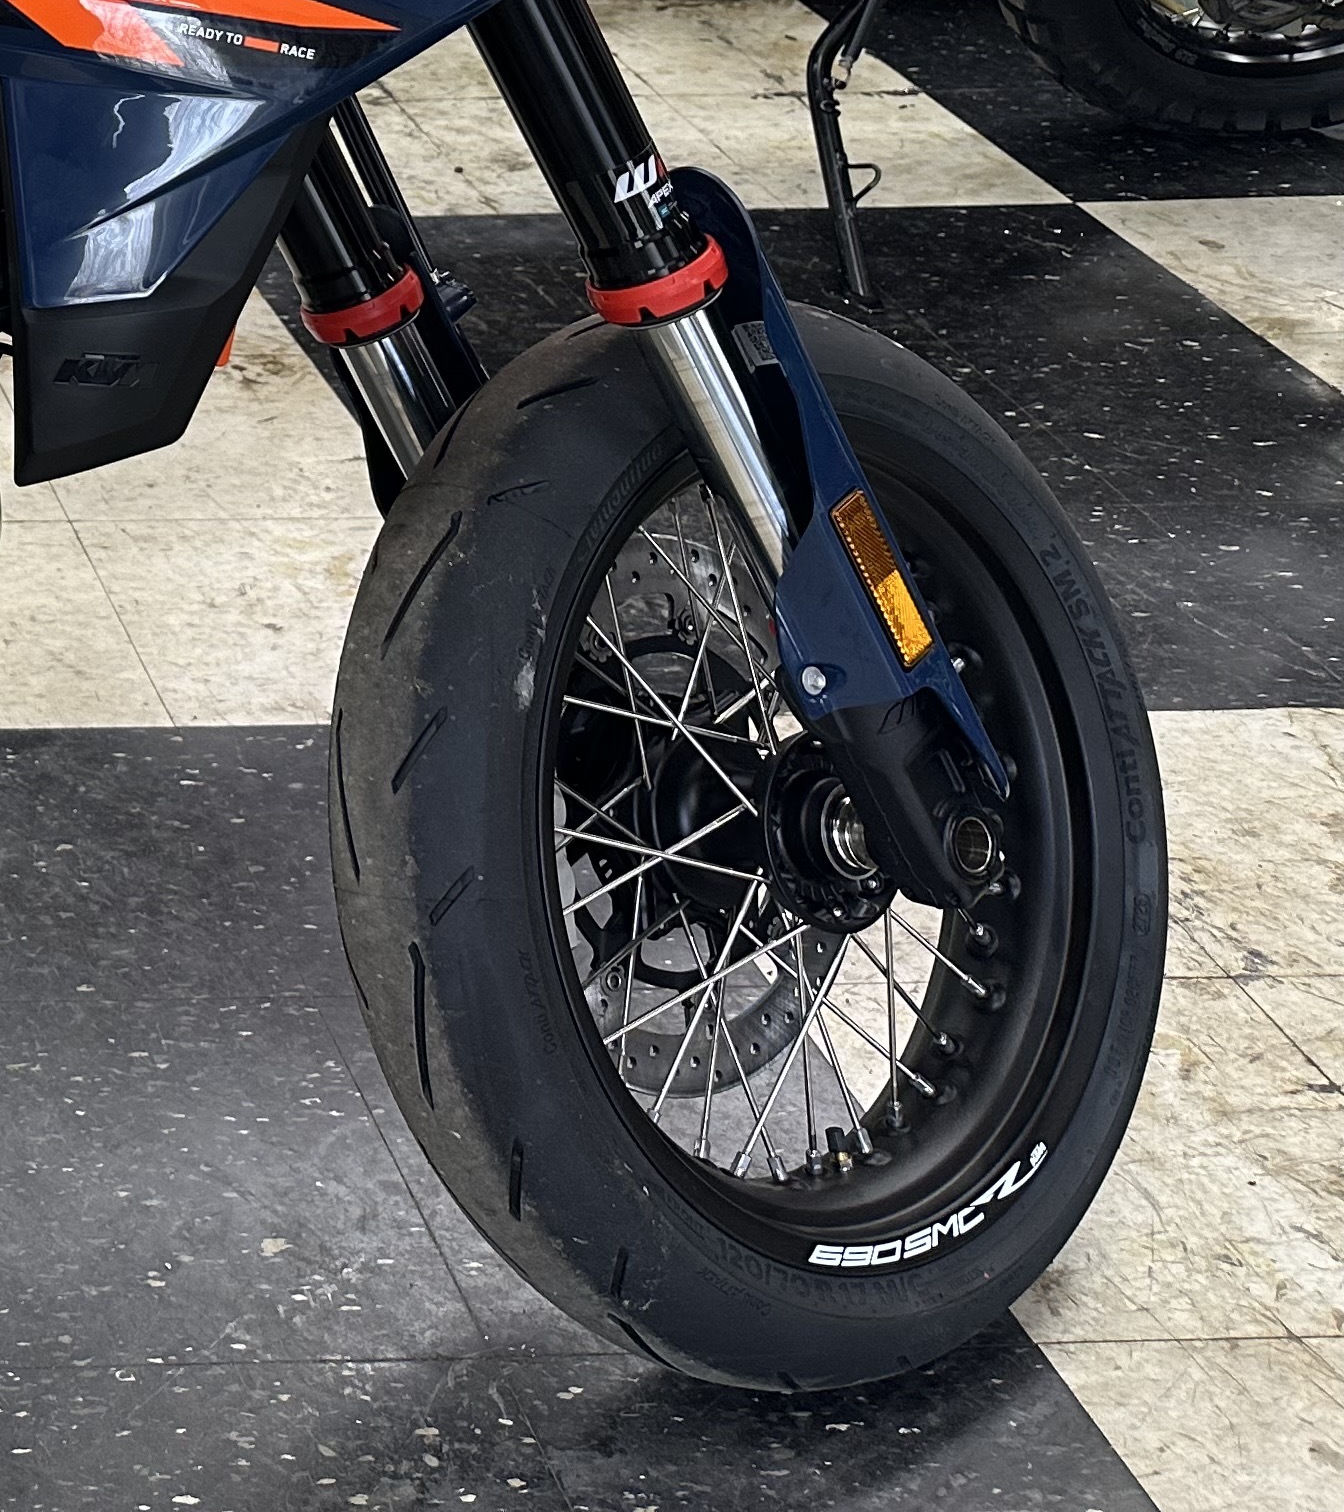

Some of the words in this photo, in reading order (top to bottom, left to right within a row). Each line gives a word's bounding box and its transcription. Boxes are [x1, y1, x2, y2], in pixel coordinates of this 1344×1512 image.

[178, 22, 224, 41] READY
[225, 31, 244, 46] TO
[279, 42, 317, 61] RACE
[647, 181, 674, 209] APEX
[53, 352, 160, 387] KTM
[808, 1239, 903, 1267] 690
[903, 1206, 985, 1260] SMC
